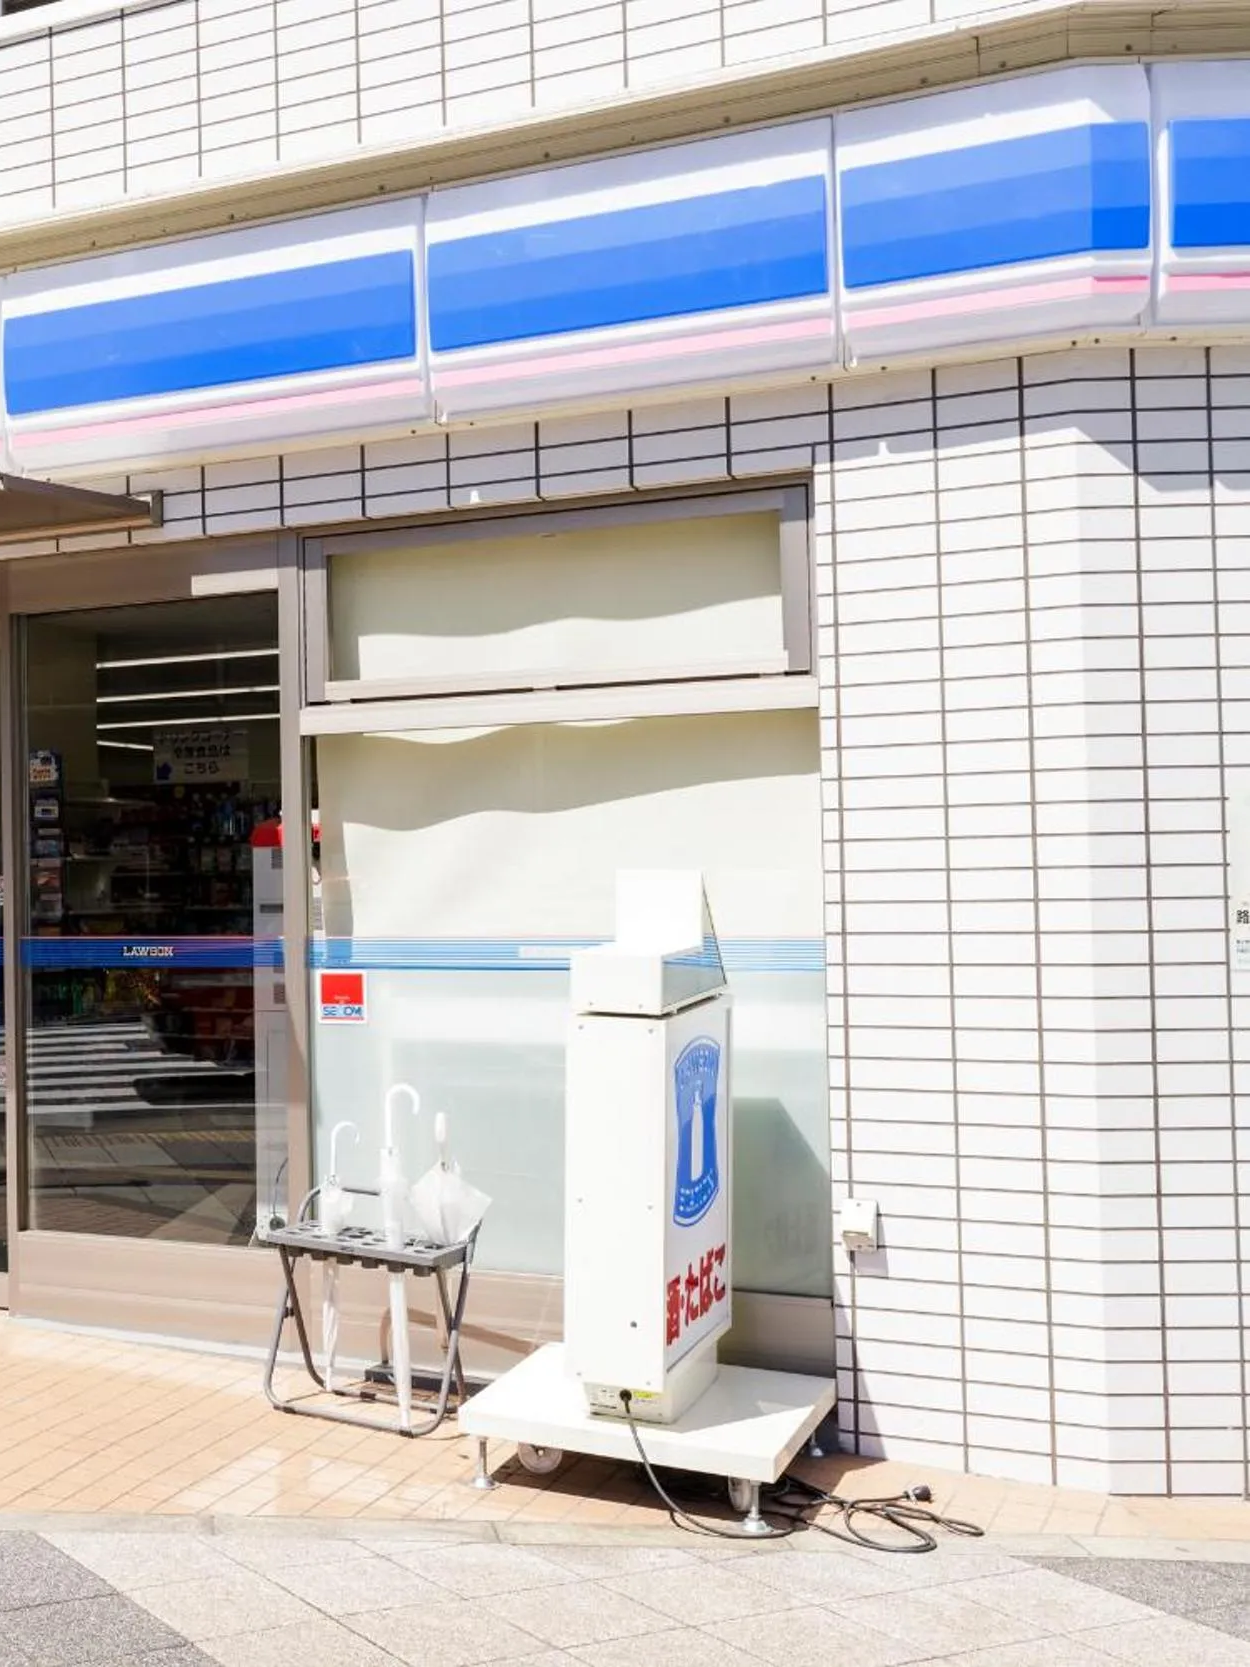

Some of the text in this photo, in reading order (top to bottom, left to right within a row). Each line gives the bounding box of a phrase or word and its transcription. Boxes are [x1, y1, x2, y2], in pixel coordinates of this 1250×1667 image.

[184, 761, 220, 775] こちら
[122, 946, 174, 957] LAWSON
[322, 1006, 362, 1016] SEOM
[666, 1244, 726, 1345] 酒・たばこ
